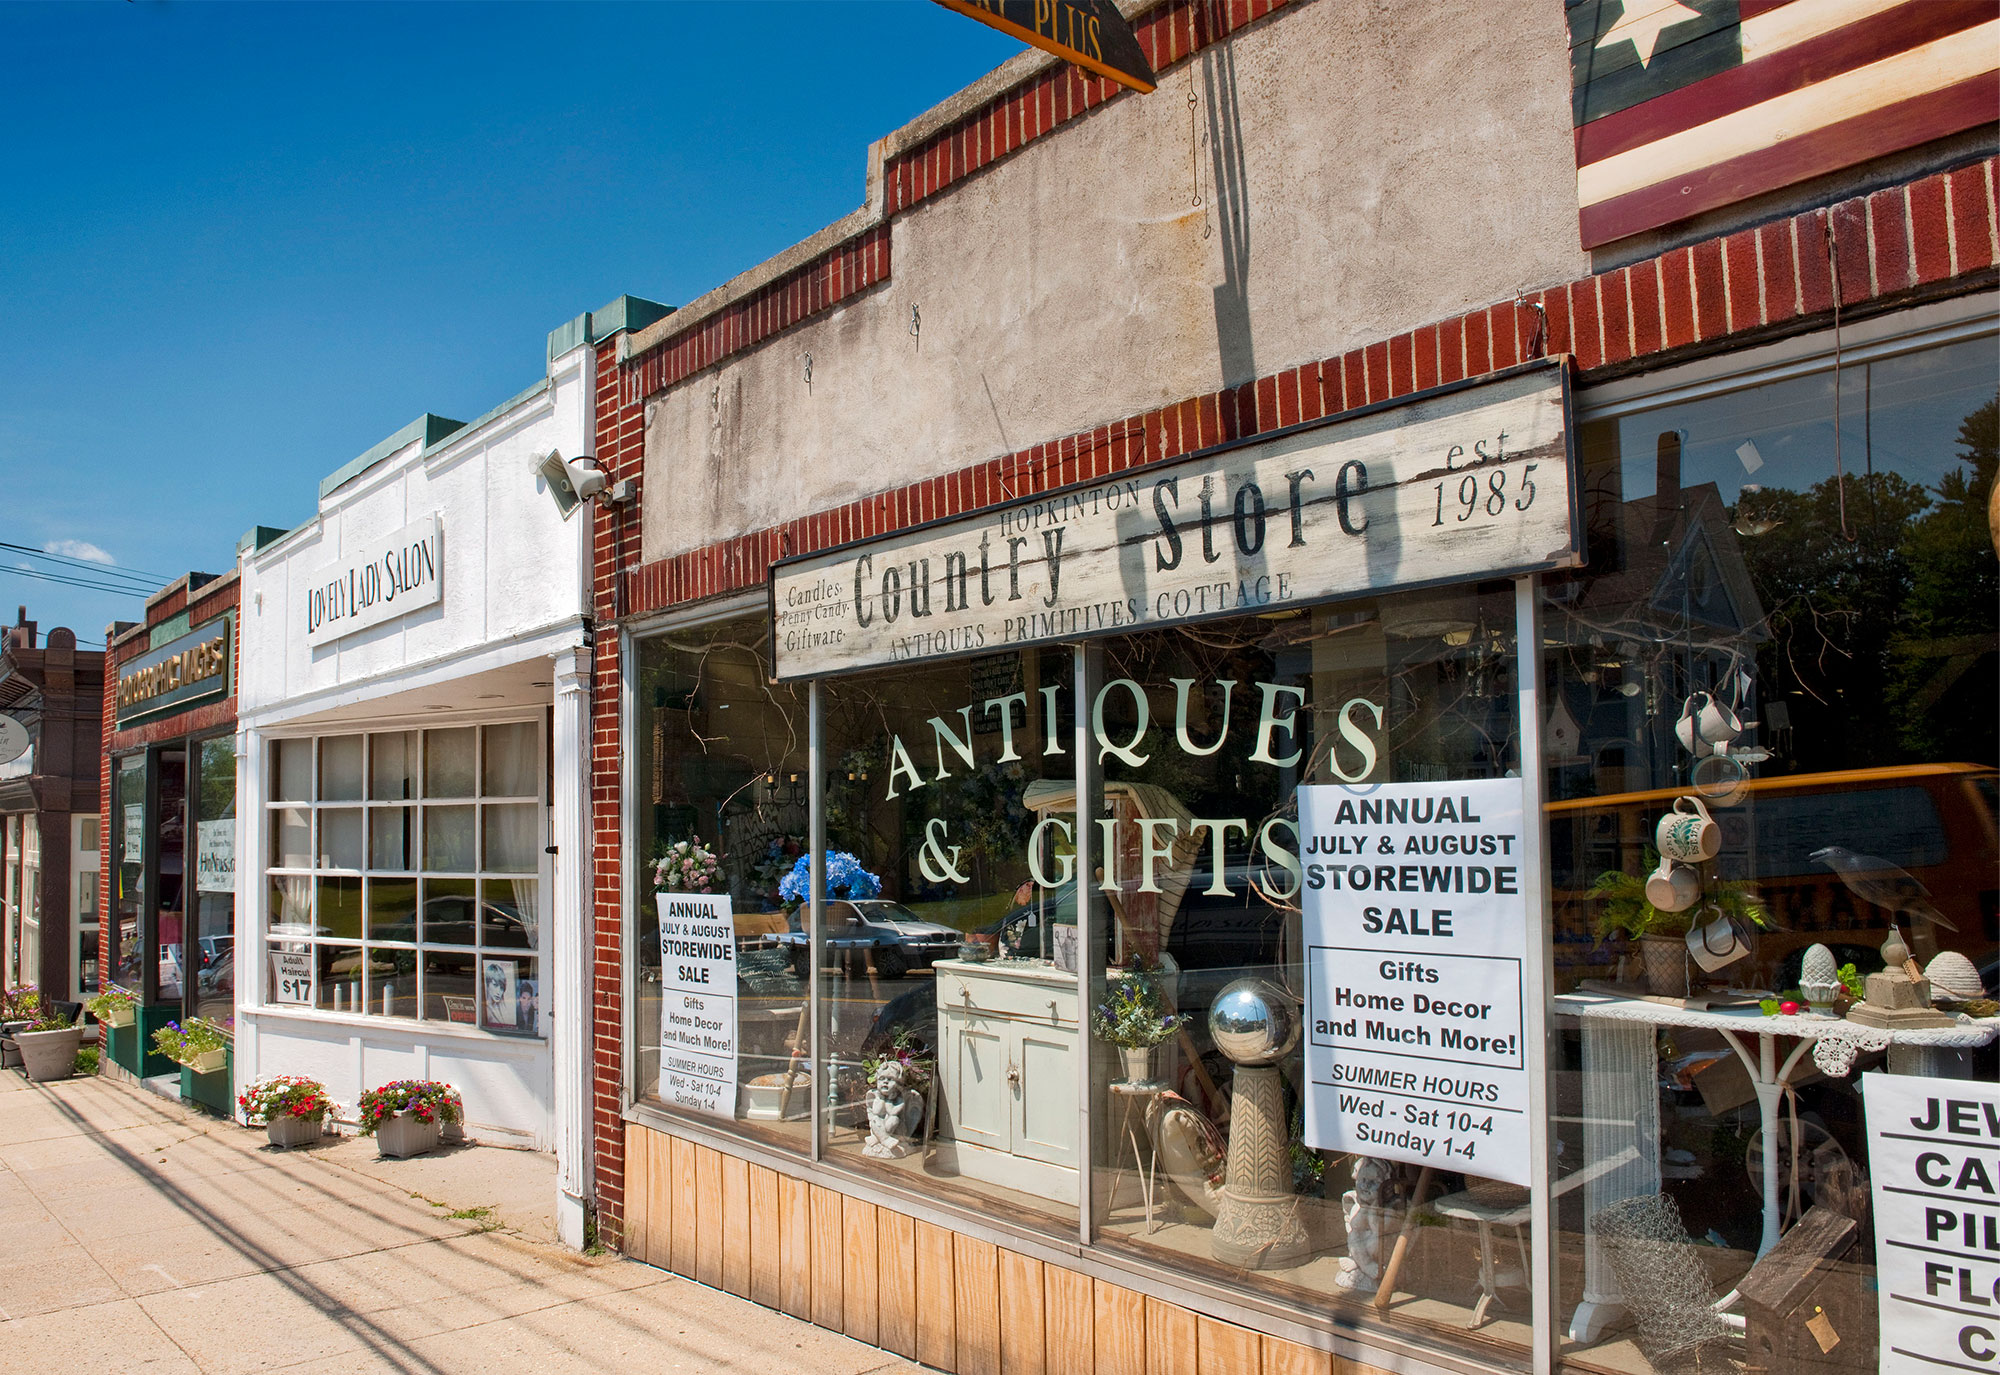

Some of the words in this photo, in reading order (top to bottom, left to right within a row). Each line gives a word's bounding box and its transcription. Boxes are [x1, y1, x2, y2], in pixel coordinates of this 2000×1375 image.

[1431, 463, 1538, 527] 1985
[1000, 479, 1140, 538] HOPKINTON
[854, 525, 1067, 630] Country
[1152, 459, 1370, 573] Store
[349, 557, 384, 618] LADY
[384, 534, 435, 602] SALON
[781, 610, 812, 627] Penny
[888, 624, 985, 661] ANTIQUES
[1004, 597, 1137, 643] PRIMITIVES
[1156, 571, 1293, 619] COTTAGE
[885, 677, 1384, 802] ANTIQUES
[1334, 796, 1481, 825] ANNUAL
[1306, 835, 1369, 855] JULY
[1377, 835, 1396, 855] &
[1404, 834, 1516, 855] AUGUST
[918, 817, 970, 884] &
[1028, 817, 1303, 900] GIFTS
[1306, 864, 1519, 895] STOREWIDE
[669, 901, 718, 920] ANNUAL
[1362, 906, 1454, 937] SALE
[661, 922, 681, 935] JULY
[682, 924, 690, 936] &
[691, 925, 730, 939] AUGUST
[283, 956, 304, 965] Adult
[662, 939, 732, 961] STOREWIDE
[281, 966, 311, 977] Haircut
[678, 965, 710, 984] SALE
[1379, 960, 1440, 984] Gifts
[282, 978, 311, 1001] $17
[683, 996, 705, 1011] Gifts
[1335, 987, 1405, 1012] Home
[1413, 994, 1492, 1020] Decor
[669, 1012, 693, 1027] Home
[695, 1015, 723, 1031] Decor
[664, 1030, 677, 1042] and
[679, 1031, 701, 1047] Much
[703, 1036, 731, 1051] More!
[1315, 1018, 1357, 1038] and
[1365, 1020, 1431, 1046] Much
[1440, 1027, 1516, 1055] More!
[668, 1056, 696, 1072] SUMMER
[698, 1063, 724, 1078] HOURS
[669, 1074, 686, 1089] Wed
[691, 1079, 705, 1094] Sat
[705, 1082, 721, 1097] 10-4
[1332, 1063, 1418, 1091] SUMMER
[1423, 1075, 1500, 1102] HOURS
[675, 1090, 702, 1110] Sunday
[703, 1097, 716, 1111] 1-4
[1339, 1094, 1384, 1119] Wed
[1404, 1104, 1439, 1128] Sat
[1446, 1110, 1494, 1136] 10-4
[1355, 1122, 1435, 1157] Sunday
[1442, 1137, 1476, 1161] 1-4
